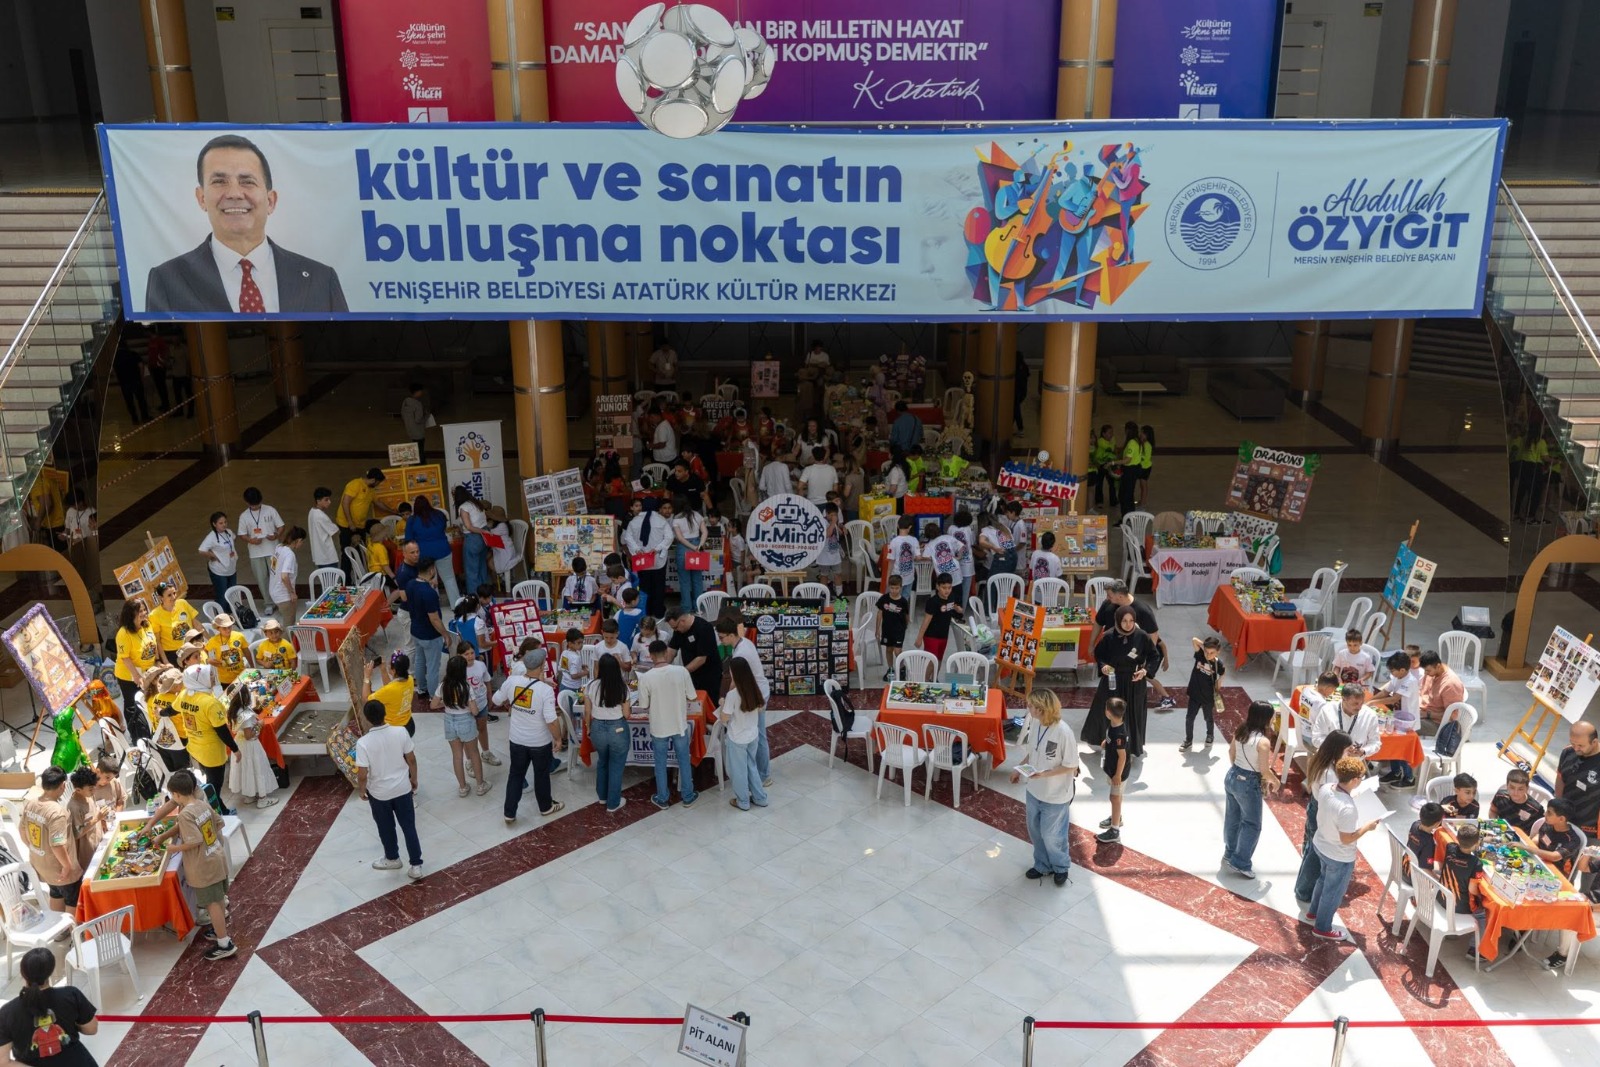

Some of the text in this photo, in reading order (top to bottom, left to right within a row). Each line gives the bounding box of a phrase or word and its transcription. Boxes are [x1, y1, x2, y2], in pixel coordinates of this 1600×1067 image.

[410, 23, 445, 31] Kültürün
[765, 20, 797, 39] BİR
[801, 20, 891, 39] MİLLETİN
[897, 19, 963, 38] HAYAT
[1196, 20, 1231, 28] Kültürün
[1212, 28, 1230, 36] şehri
[427, 31, 446, 40] şehri
[782, 42, 872, 66] KOPMUŞ
[355, 146, 902, 203] kültür ve sanatın
[1323, 177, 1447, 219] Abdullah
[1169, 200, 1185, 235] MERSİN
[1182, 182, 1228, 201] YENİŞEHİR
[1288, 206, 1470, 251] ÖZYİĞİT
[361, 208, 899, 277] buluşma noktası
[1294, 252, 1456, 264] MERSİN YENİŞEHİR BELEDİYE BAŞKANI
[369, 279, 896, 304] YENİŞEHİR BELEDİYESİ ATATÜRK KÜLTÜR MERKEZİ
[596, 394, 632, 403] ARKEOTEK
[598, 402, 629, 412] JUNIOR
[706, 409, 730, 419] TEAM
[1254, 449, 1304, 466] DRAGONS
[749, 524, 818, 544] Jr.Mind
[777, 615, 820, 626] Jr.Mind
[632, 727, 647, 738] 24
[689, 1026, 705, 1040] PİT
[705, 1034, 736, 1054] ALANI
